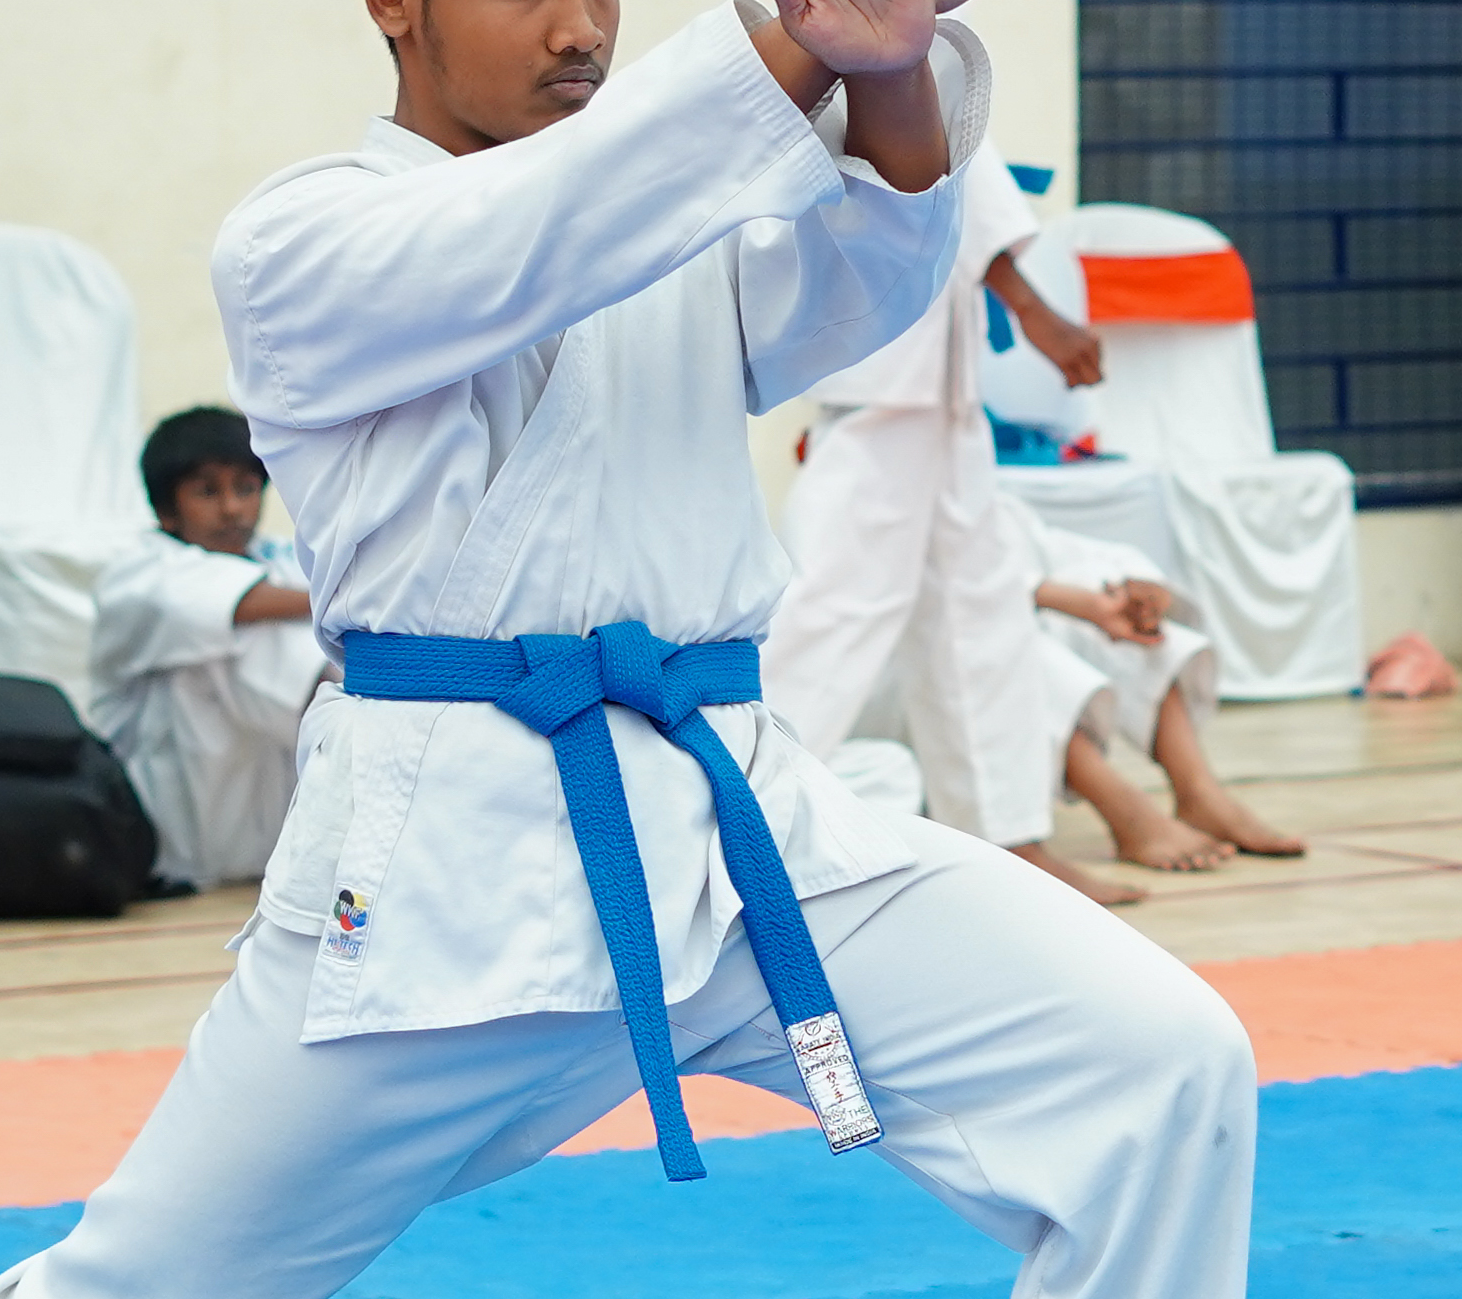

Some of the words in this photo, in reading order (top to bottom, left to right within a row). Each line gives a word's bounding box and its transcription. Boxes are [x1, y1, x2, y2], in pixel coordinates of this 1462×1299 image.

[340, 900, 363, 918] WKF
[804, 1054, 849, 1074] APPROVED
[847, 1106, 868, 1118] THE
